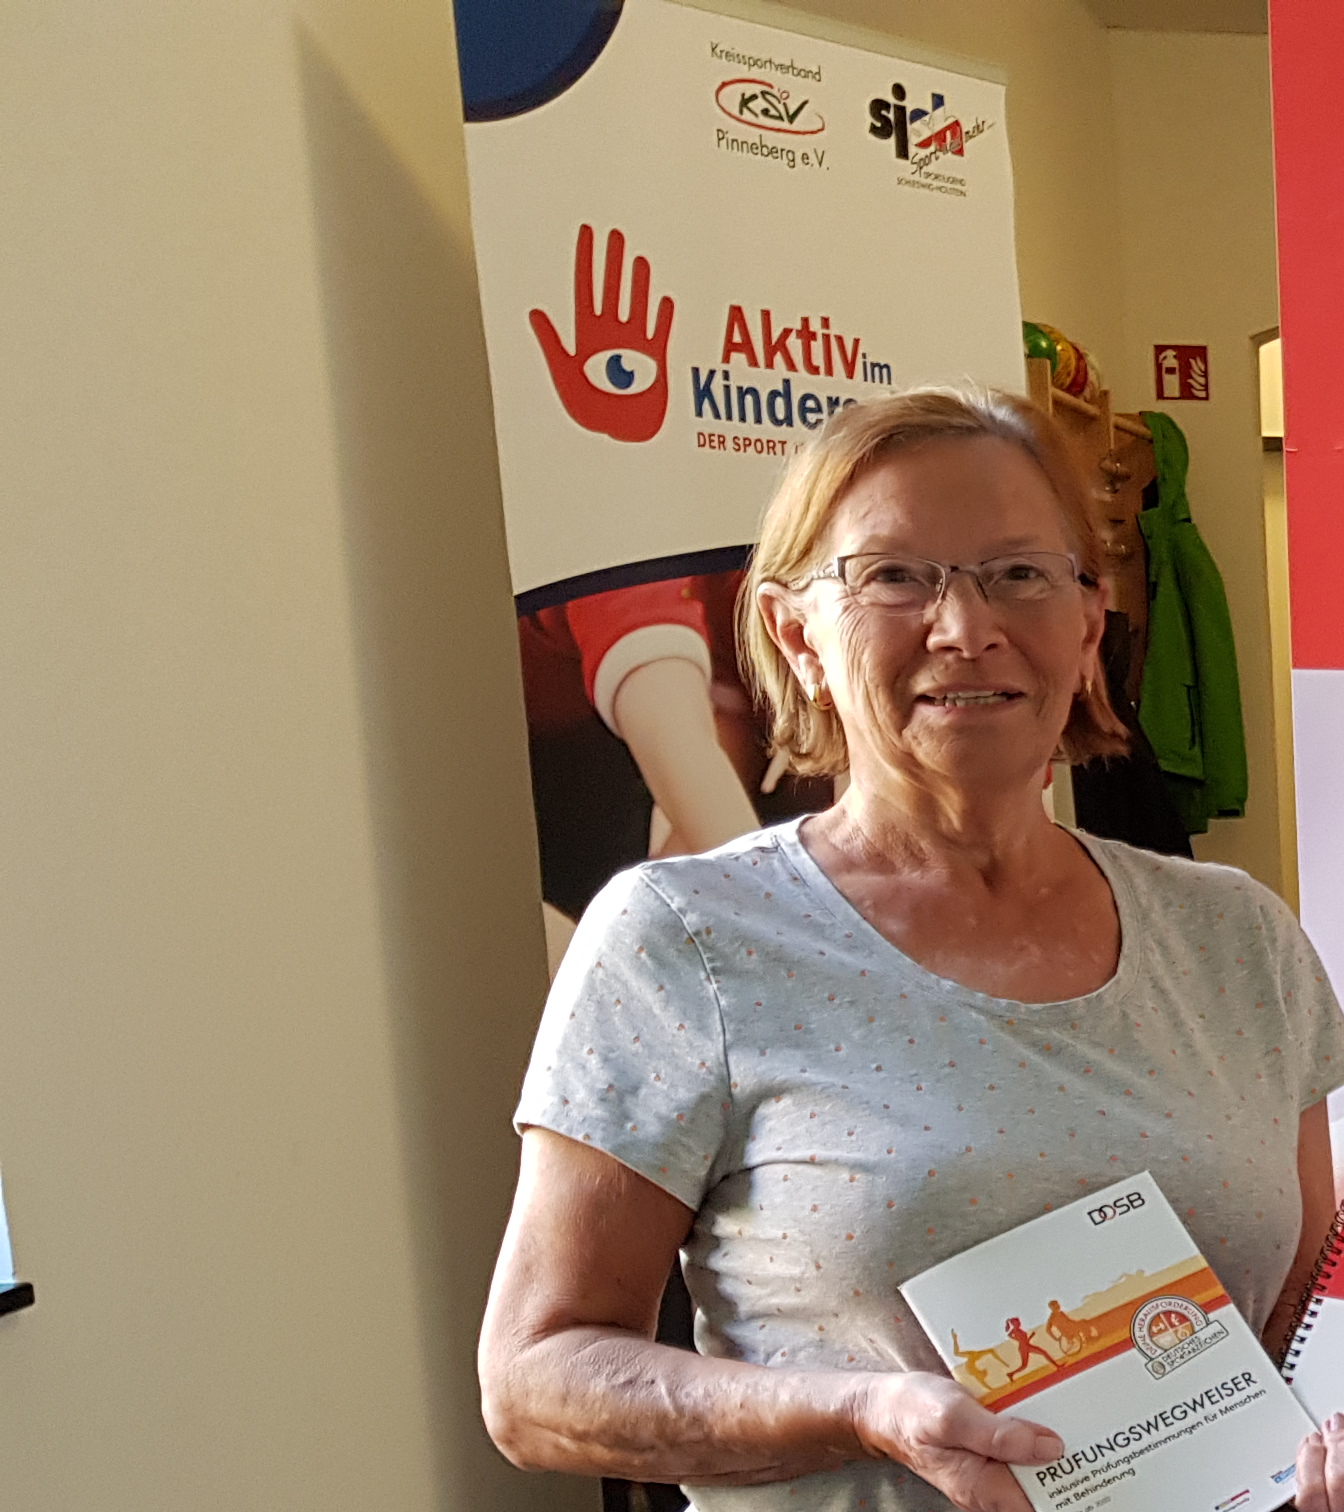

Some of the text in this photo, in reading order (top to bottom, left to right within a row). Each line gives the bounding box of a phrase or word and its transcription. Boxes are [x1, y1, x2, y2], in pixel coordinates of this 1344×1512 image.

[709, 41, 822, 82] Kreissportverband
[738, 89, 810, 125] KSV
[716, 128, 830, 171] Pinneberg e.V.
[721, 304, 893, 386] Aktiv im
[697, 431, 788, 456] DER SPORT
[1087, 1191, 1147, 1226] DOSB
[1035, 1370, 1259, 1488] PRÜFUNGSWEGWEISER
[1046, 1386, 1268, 1501] inklusive Prüfungsbestimmungen für Menschen
[1053, 1465, 1138, 1512] mit Behinderung
